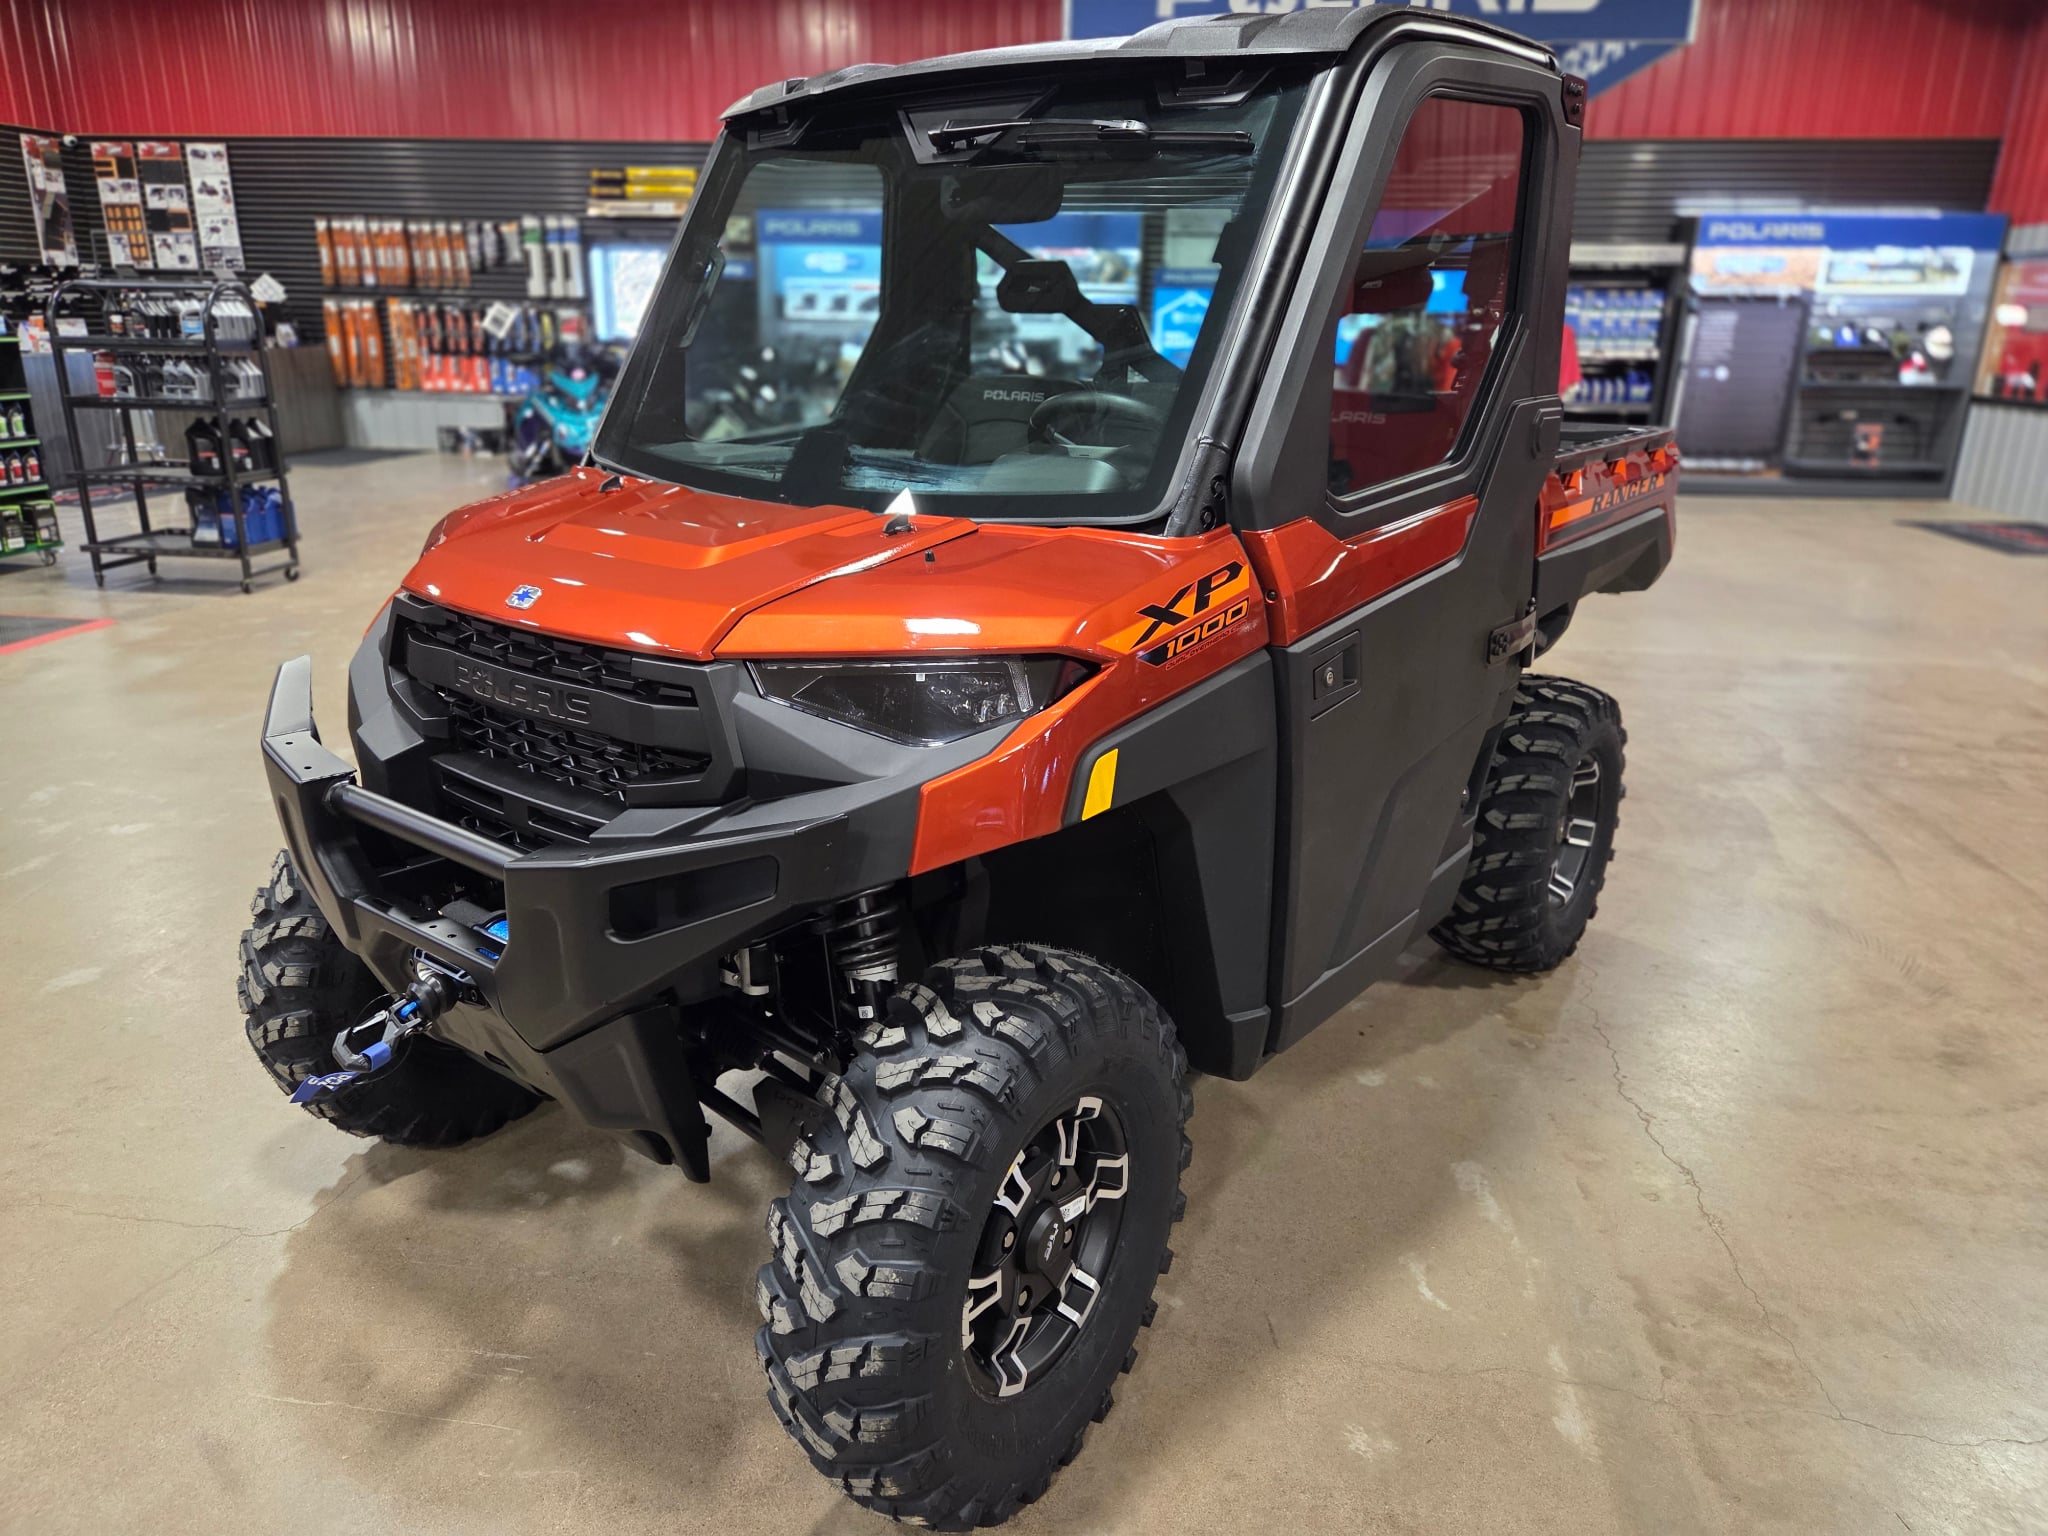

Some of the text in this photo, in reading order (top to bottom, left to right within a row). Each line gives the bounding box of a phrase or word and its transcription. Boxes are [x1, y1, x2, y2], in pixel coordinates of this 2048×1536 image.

[1709, 222, 1824, 240] POLARIS
[983, 389, 1045, 402] POLARIS
[1591, 474, 1661, 514] RANGER
[1129, 560, 1244, 650] XP
[1166, 600, 1248, 659] 1000
[454, 659, 593, 725] POLARIS
